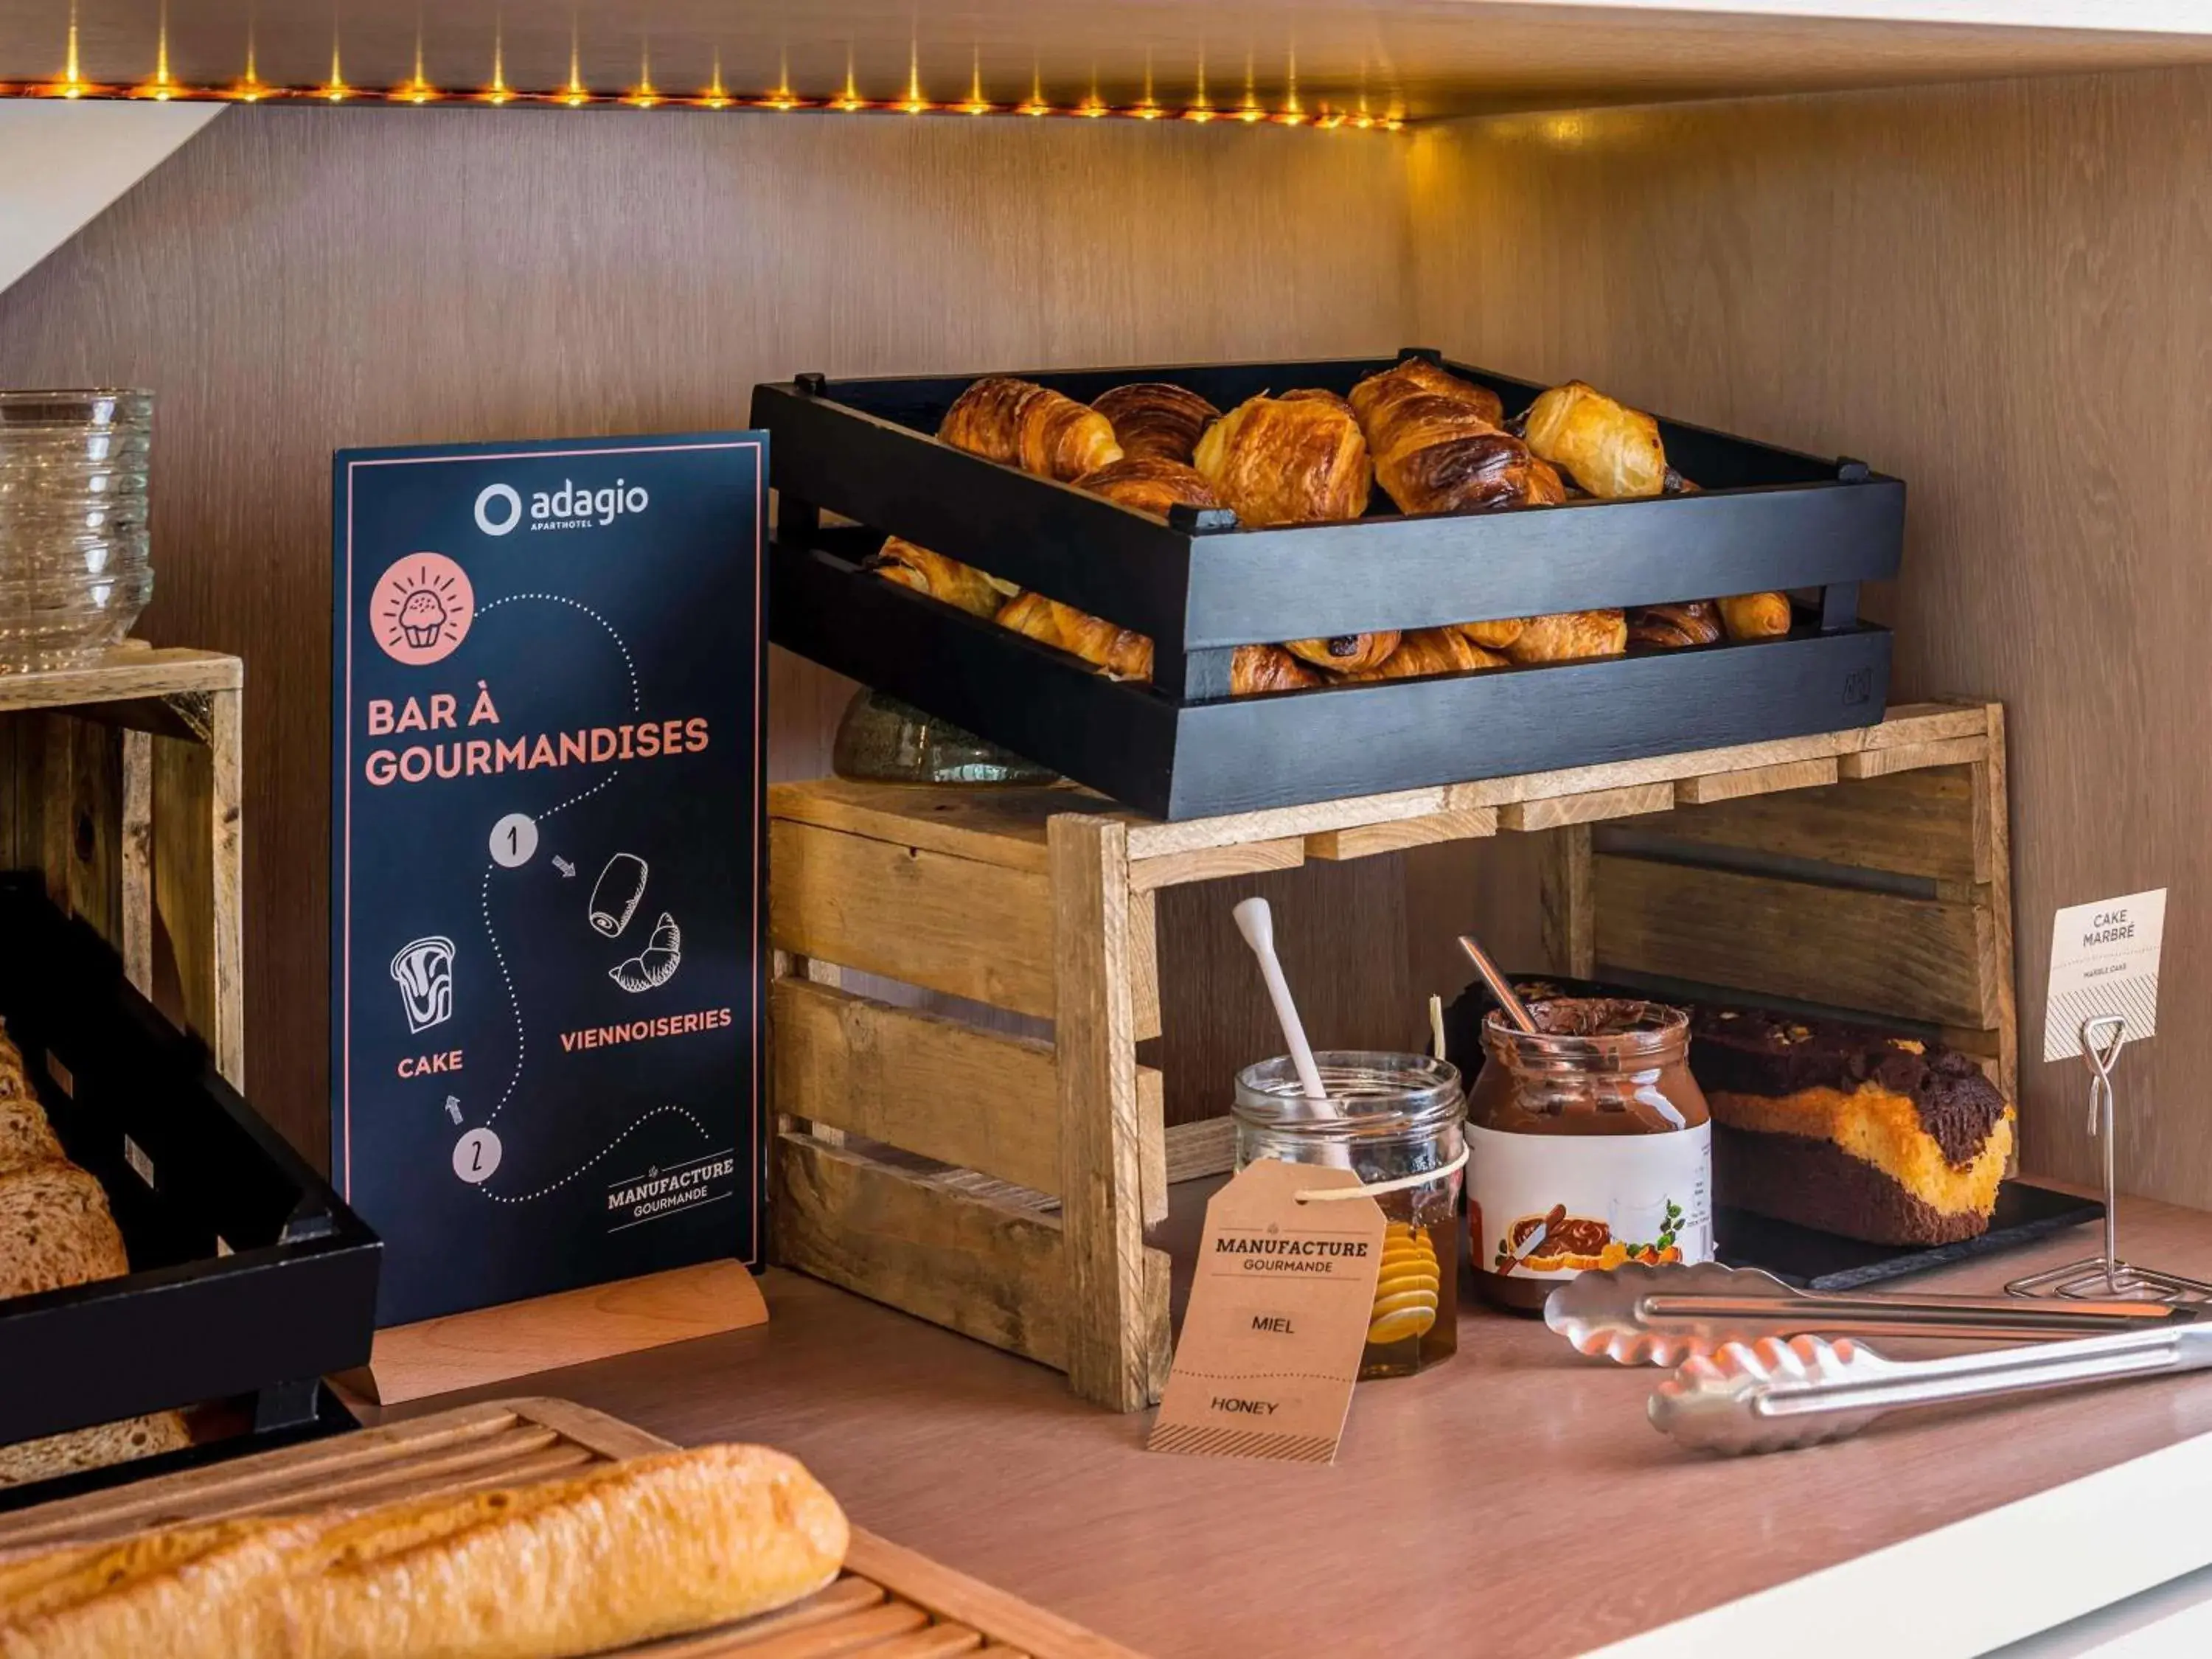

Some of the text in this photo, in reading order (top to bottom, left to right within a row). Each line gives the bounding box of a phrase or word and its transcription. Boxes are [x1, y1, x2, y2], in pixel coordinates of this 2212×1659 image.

[530, 478, 649, 526] adagio
[530, 520, 593, 531] APARTHOTEL
[368, 680, 500, 735] BAR À
[364, 717, 709, 786] GOURMANDISES
[507, 826, 518, 856] 1
[2093, 909, 2128, 928] CAKE
[2082, 921, 2135, 947] MARBRÉ
[2110, 963, 2126, 973] CAKE
[560, 1007, 733, 1052] VIENNOISERIES
[397, 1049, 464, 1079] CAKE
[471, 1141, 481, 1176] 2
[608, 1158, 734, 1209] MANUFACTURE
[633, 1185, 709, 1217] GOURMANDE
[1215, 1237, 1369, 1258] MANUFACTURE
[1243, 1259, 1334, 1273] GOURMANDE
[1251, 1315, 1295, 1335] MIEL
[1211, 1397, 1280, 1416] HONEY
